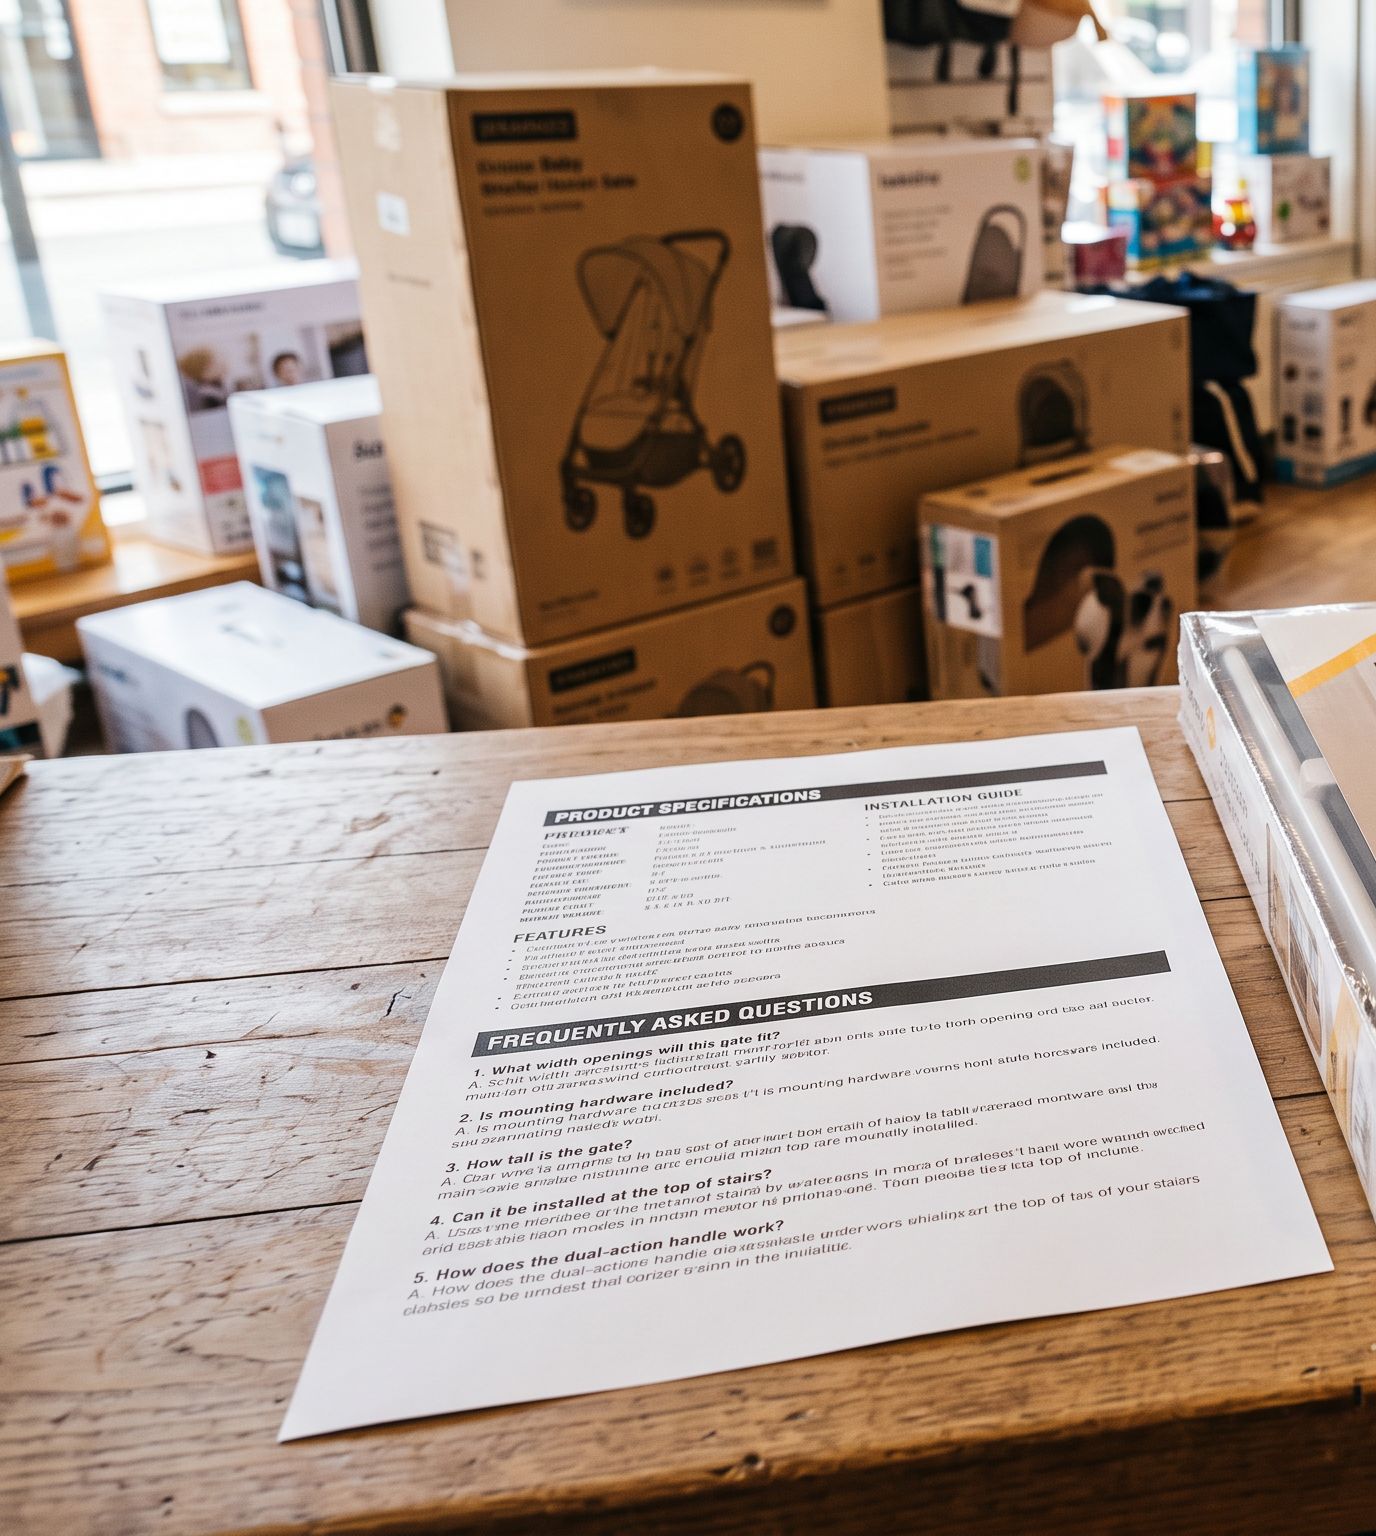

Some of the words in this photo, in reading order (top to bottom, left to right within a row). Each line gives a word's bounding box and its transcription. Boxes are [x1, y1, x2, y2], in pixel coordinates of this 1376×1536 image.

[553, 804, 655, 824] PRODUCT
[657, 789, 822, 815] SPECIFICATIONS
[864, 794, 972, 811] INSTALLATION
[977, 789, 1022, 800] GUIDE
[513, 925, 607, 944] FEATURES
[486, 1018, 647, 1051] FREQUENTLY
[653, 1004, 732, 1031] ASKED
[739, 990, 874, 1022] QUESTIONS
[467, 1080, 482, 1090] A.
[980, 1011, 1033, 1025] opening
[474, 1068, 485, 1077] 1.
[492, 1063, 531, 1076] What
[536, 1057, 578, 1070] width
[582, 1049, 653, 1065] openings
[658, 1043, 684, 1055] will
[688, 1040, 715, 1051] this
[720, 1036, 753, 1048] gate
[757, 1031, 780, 1042] fit?
[454, 1126, 470, 1136] A.
[476, 1124, 489, 1134] Is
[492, 1116, 564, 1132] mounting
[568, 1106, 637, 1121] hardware
[763, 1087, 774, 1096] is
[778, 1079, 844, 1094] mounting
[848, 1069, 911, 1085] hardware
[1101, 1035, 1160, 1051] included.
[459, 1113, 473, 1123] 2.
[479, 1111, 493, 1121] Is
[498, 1102, 575, 1119] mounting
[579, 1092, 654, 1109] hardware
[658, 1079, 734, 1098] included?
[440, 1177, 456, 1187] A.
[714, 1139, 729, 1150] of
[867, 1118, 881, 1128] of
[445, 1162, 460, 1173] 3.
[466, 1158, 504, 1170] How
[508, 1152, 534, 1165] tall
[538, 1150, 553, 1161] is
[558, 1147, 583, 1158] the
[588, 1139, 633, 1157] gate?
[1039, 1156, 1063, 1166] top
[1067, 1151, 1082, 1163] of
[424, 1230, 441, 1241] A.
[935, 1157, 949, 1168] of
[1063, 1138, 1098, 1150] wore
[429, 1215, 444, 1226] 4.
[452, 1211, 485, 1223] Can
[490, 1207, 502, 1218] it
[506, 1205, 527, 1216] be
[532, 1192, 606, 1213] installed
[610, 1190, 627, 1202] at
[632, 1187, 658, 1199] the
[663, 1183, 690, 1194] top
[695, 1177, 713, 1190] of
[717, 1168, 772, 1187] stairs?
[413, 1272, 429, 1284] 5.
[436, 1267, 477, 1281] How
[482, 1260, 525, 1275] does
[531, 1255, 559, 1268] the
[564, 1240, 663, 1263] dual-action
[669, 1230, 727, 1248] handle
[732, 1219, 784, 1238] work?
[432, 1284, 470, 1296] How
[474, 1278, 513, 1290] does
[520, 1273, 545, 1284] the
[994, 1202, 1018, 1213] the
[1022, 1198, 1046, 1208] top
[1051, 1193, 1065, 1204] of
[1098, 1186, 1112, 1198] of
[1117, 1182, 1150, 1196] your
[499, 1292, 520, 1302] be
[735, 1258, 750, 1268] in
[755, 1253, 780, 1265] the
